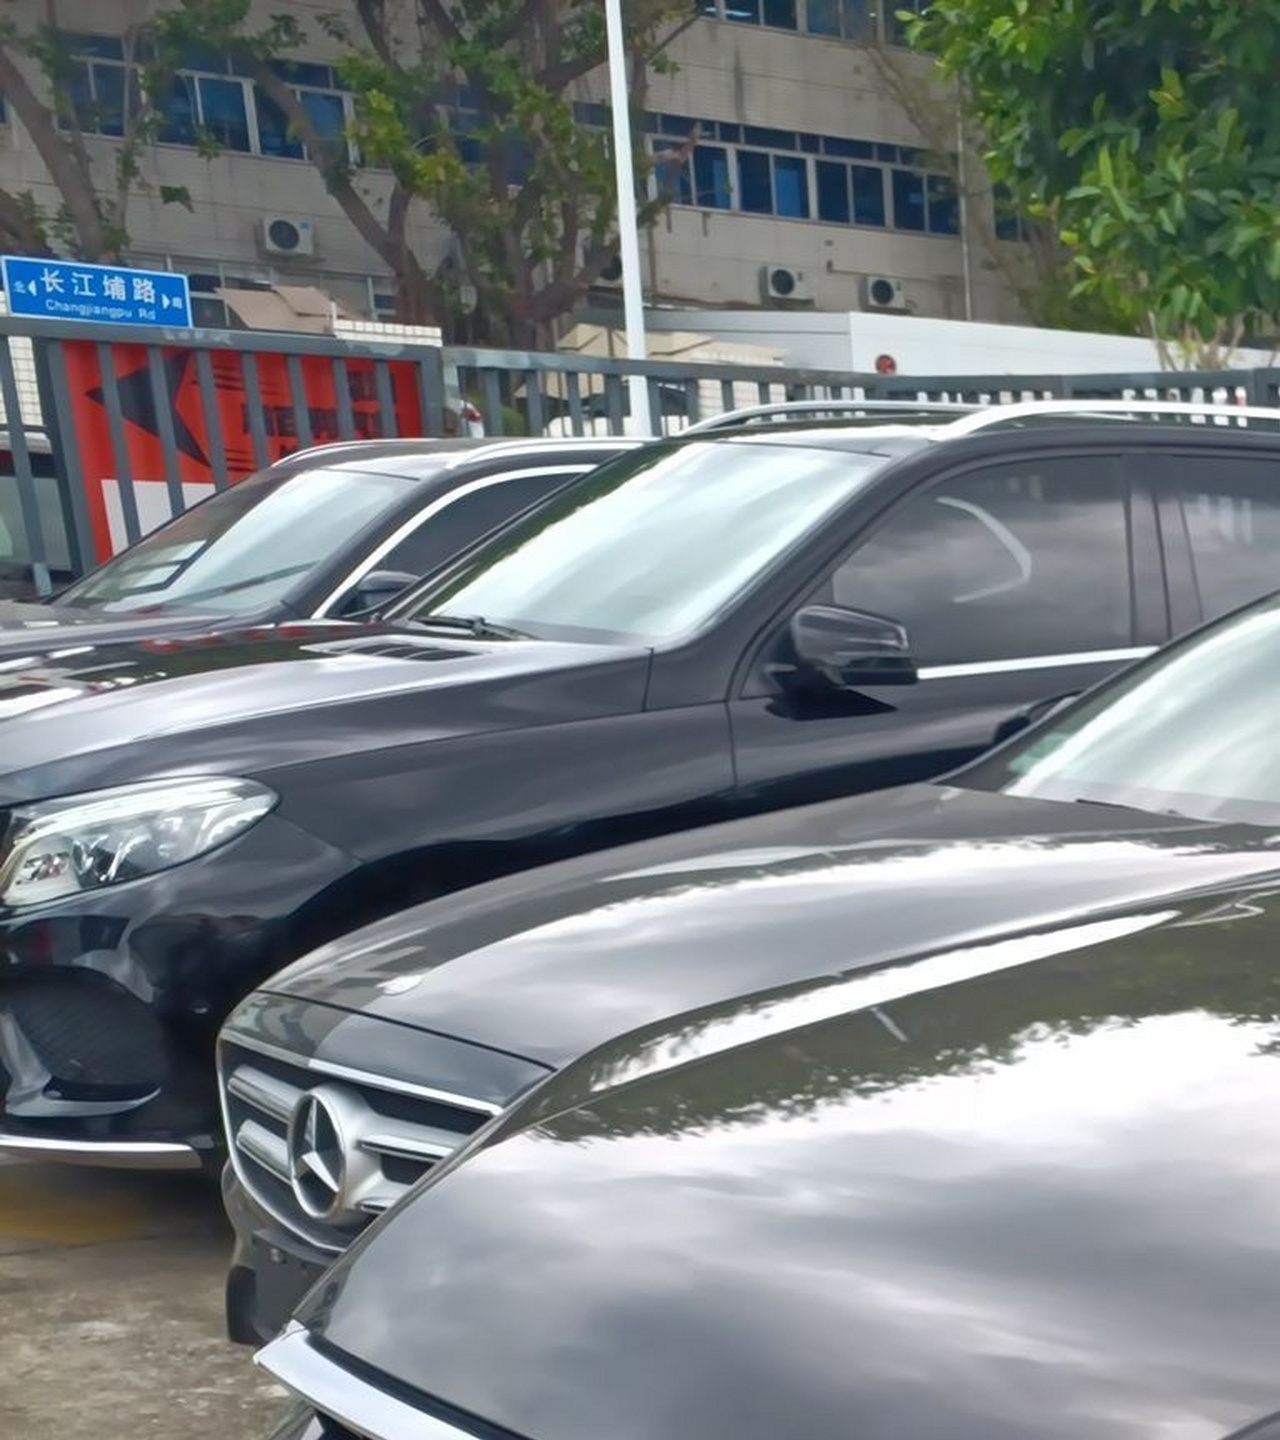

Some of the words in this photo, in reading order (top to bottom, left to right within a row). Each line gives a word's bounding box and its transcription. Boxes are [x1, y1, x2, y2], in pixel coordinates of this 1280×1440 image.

[40, 268, 156, 304] 长江埔路
[45, 299, 133, 319] Changjiangpu
[138, 307, 157, 320] Rd
